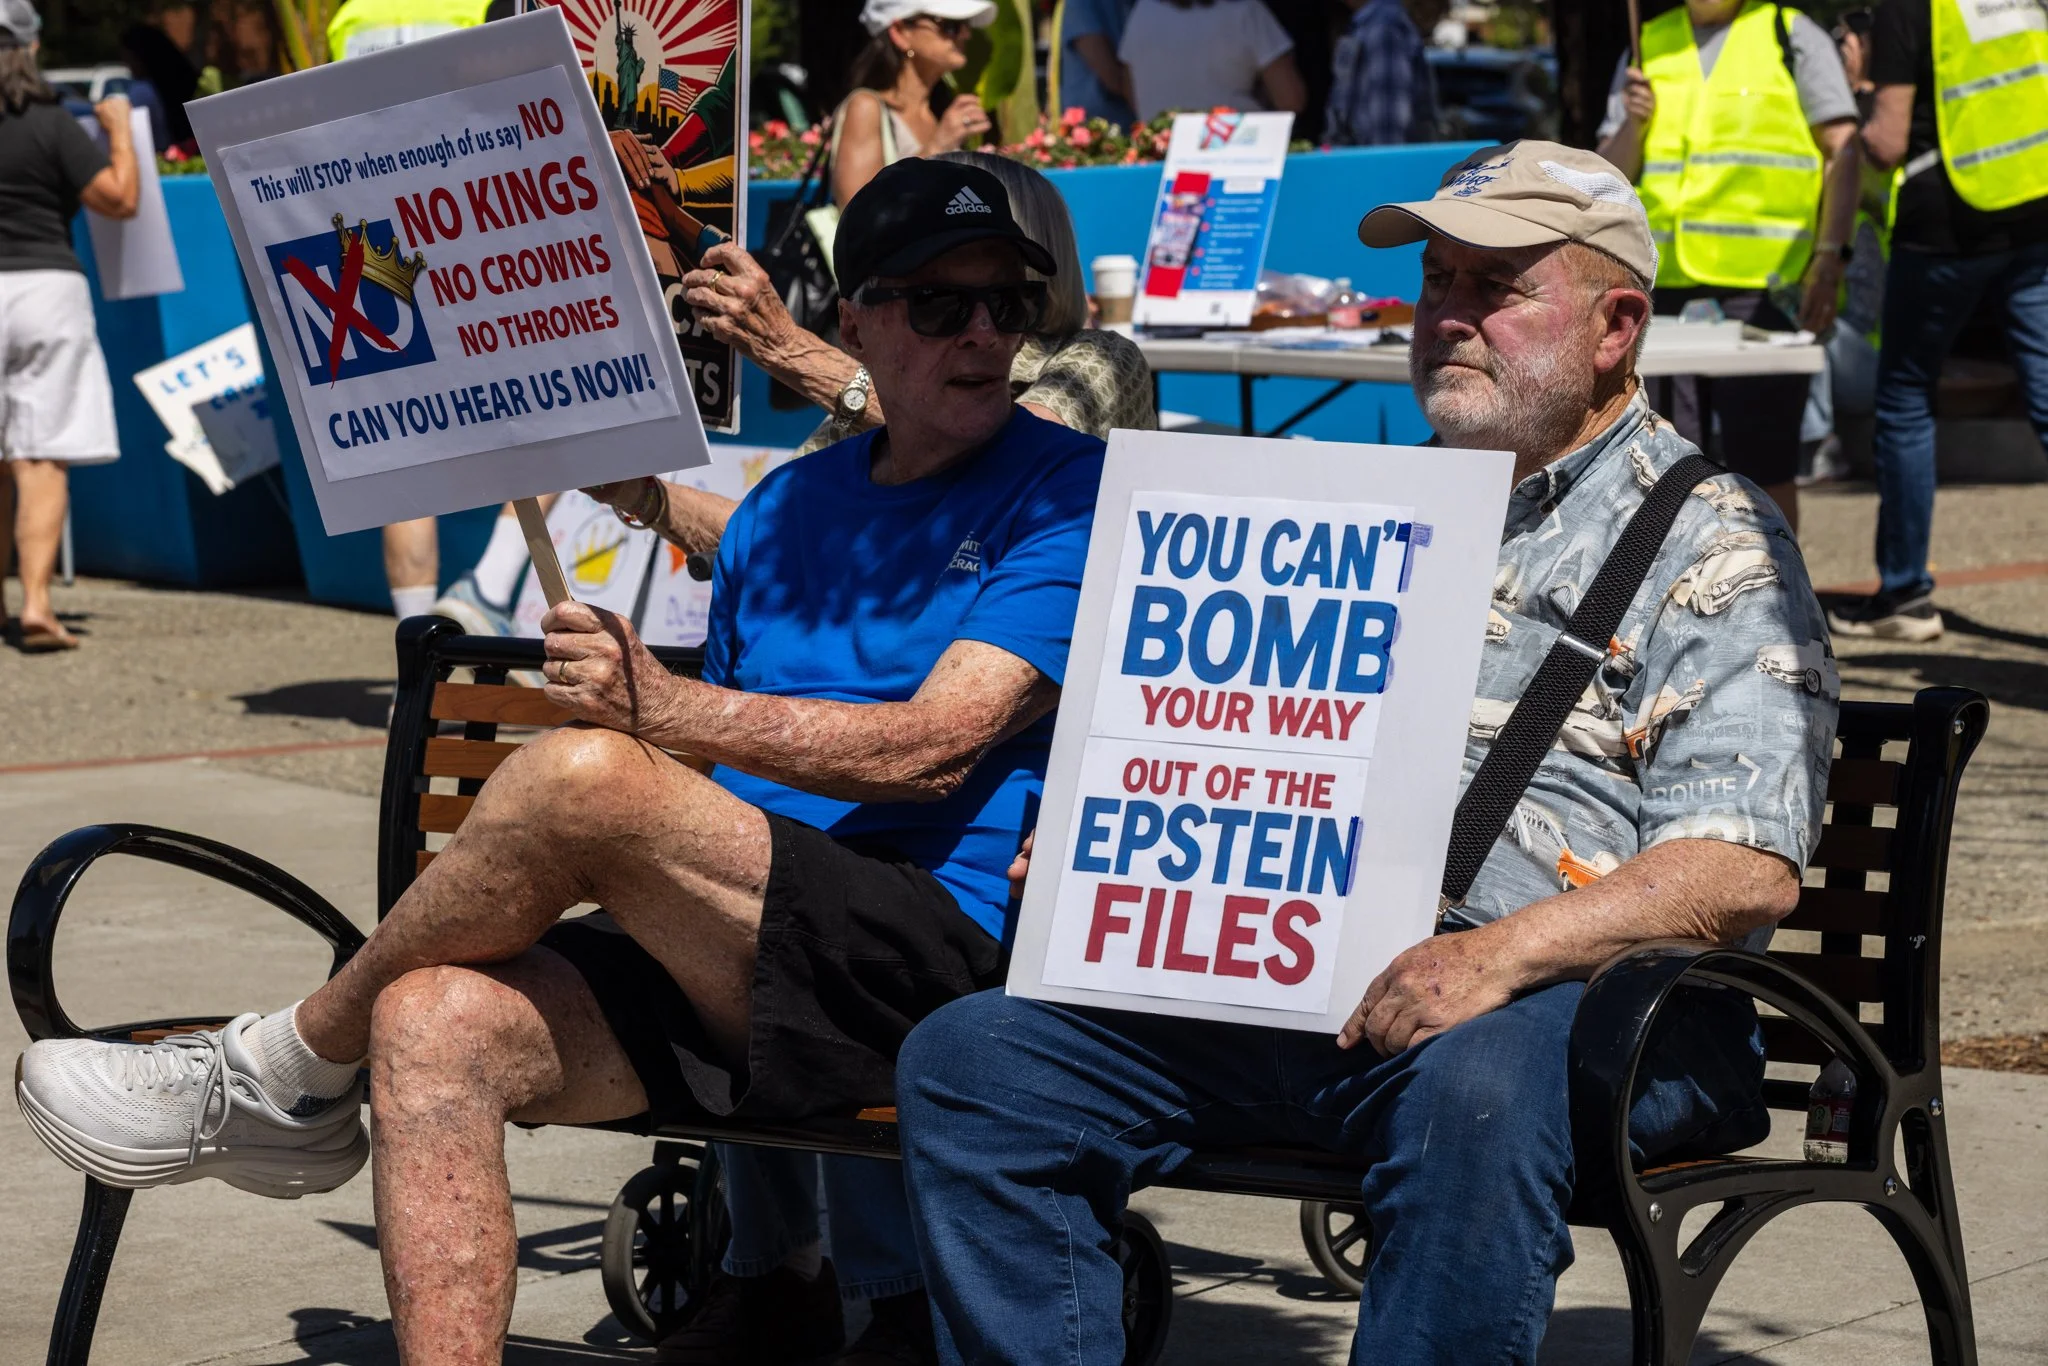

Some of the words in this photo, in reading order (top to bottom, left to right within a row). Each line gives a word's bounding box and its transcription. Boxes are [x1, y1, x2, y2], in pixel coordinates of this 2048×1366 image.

[251, 175, 285, 203] This
[286, 165, 315, 196] will
[314, 158, 353, 189] STOP
[355, 152, 396, 180] when
[399, 134, 456, 169] enough
[458, 128, 475, 155] of
[476, 130, 495, 152] us
[499, 124, 522, 150] say
[518, 97, 564, 141] NO
[394, 186, 463, 249] NO
[463, 155, 599, 233] KINGS
[945, 203, 992, 215] adidas
[428, 262, 477, 307] NO
[480, 234, 611, 296] CROWNS
[457, 320, 498, 357] NO
[497, 295, 620, 349] THRONES
[158, 346, 247, 395] LET'S
[328, 405, 390, 449] CAN
[386, 392, 449, 435] YOU
[449, 378, 532, 426] HEAR
[533, 369, 572, 411] US
[570, 353, 656, 404] NOW!
[1137, 510, 1250, 582] YOU
[1260, 518, 1434, 593] CAN'T
[1121, 585, 1402, 695] BOMB
[1140, 684, 1254, 733] YOUR
[1268, 695, 1365, 742] WAY
[1122, 757, 1198, 796] OUT
[1205, 764, 1256, 801] OF
[1265, 769, 1336, 810] THE
[1072, 796, 1364, 898] EPSTEIN
[1084, 882, 1322, 986] FILES
